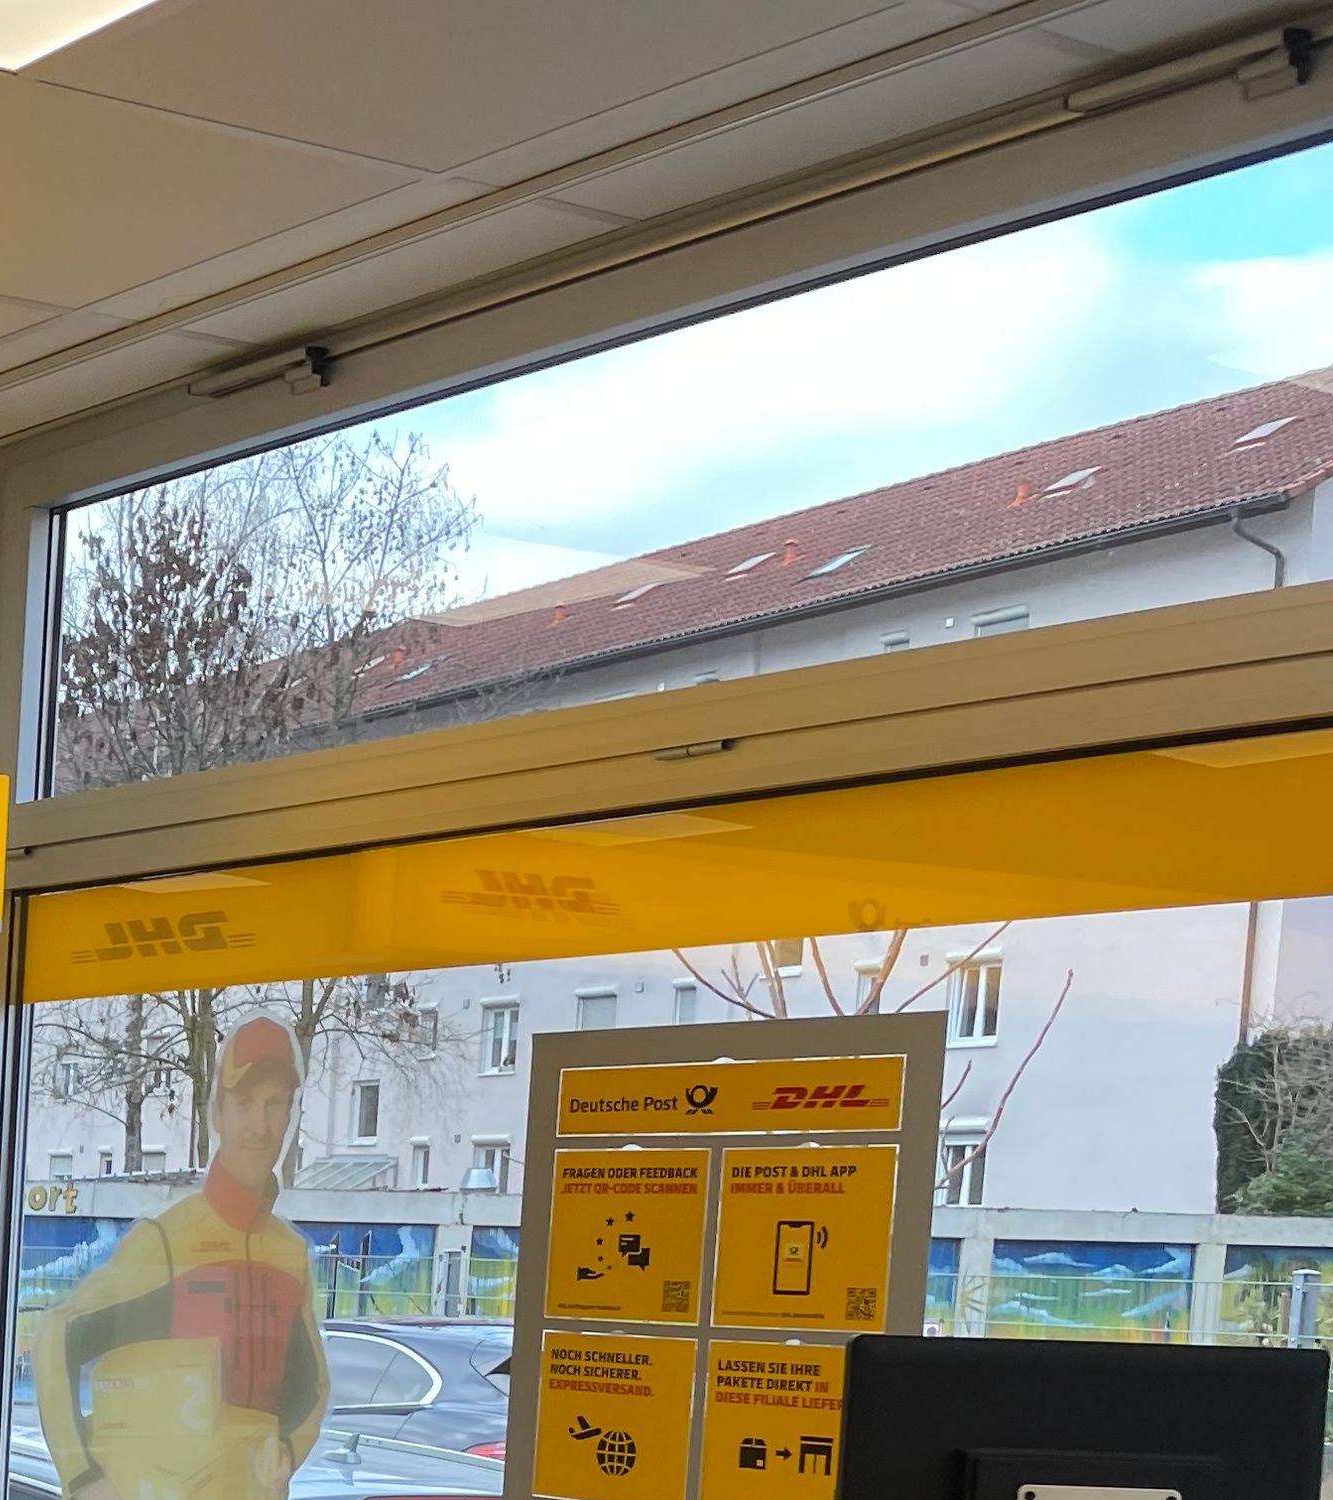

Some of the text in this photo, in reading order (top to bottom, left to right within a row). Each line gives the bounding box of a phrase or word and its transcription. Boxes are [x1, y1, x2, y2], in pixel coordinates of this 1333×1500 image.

[570, 1095, 678, 1114] Deutsche Post
[771, 1084, 870, 1110] DHL
[562, 1167, 698, 1180] FRAGEN ODER FEEDBACK
[731, 1165, 857, 1179] DIE POST & DHL APP
[560, 1182, 698, 1195] JETZT QR-CODE SCANNEN
[731, 1179, 845, 1194] IMMER & ÜBERALL
[551, 1348, 653, 1366] NOCH SCHNELLER.
[550, 1364, 642, 1381] NOCH SICHERER.
[717, 1359, 820, 1377] LASSEN SIE IHRE
[548, 1379, 655, 1398] EXPRESSVERSAND.
[716, 1375, 829, 1393] PAKETE DIREKT IN
[715, 1391, 750, 1405] DIESE
[753, 1393, 799, 1408] FILIALE
